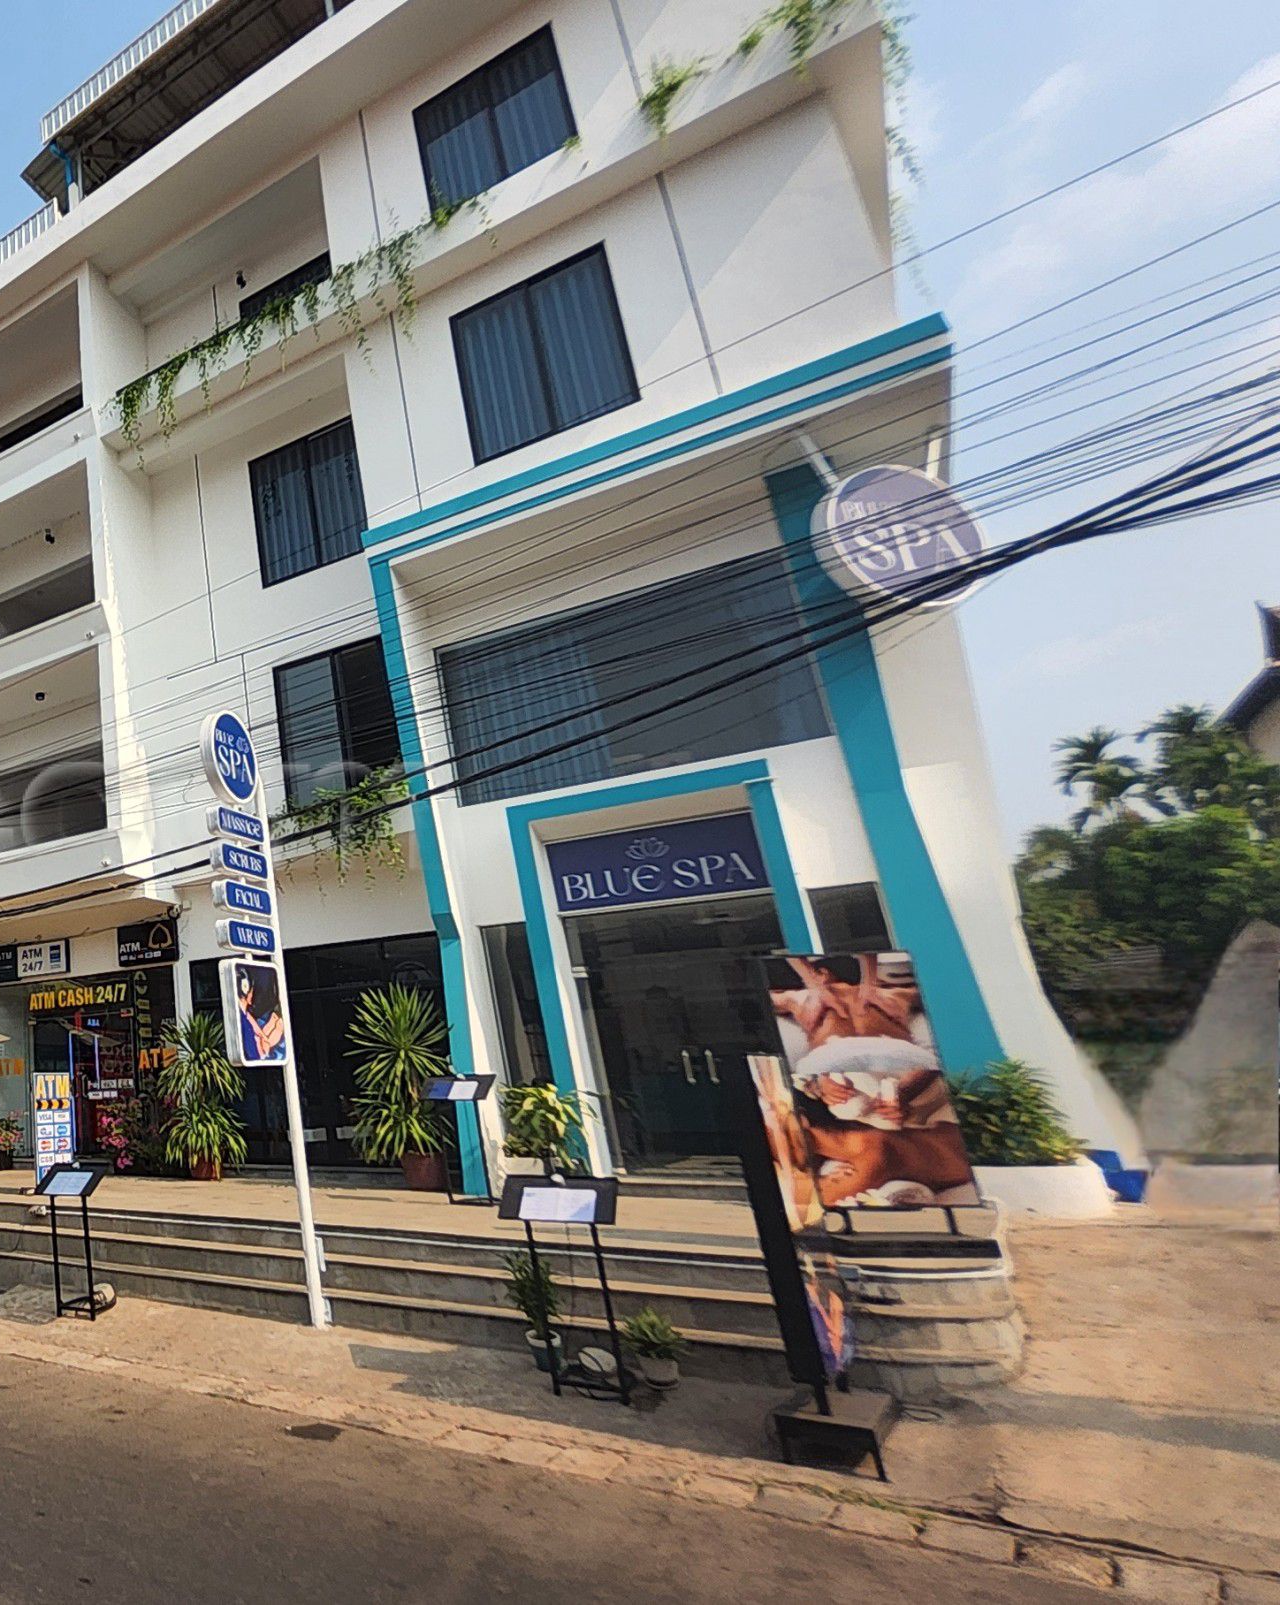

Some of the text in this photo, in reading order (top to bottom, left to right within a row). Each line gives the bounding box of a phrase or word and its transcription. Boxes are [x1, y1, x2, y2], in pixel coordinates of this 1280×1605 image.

[852, 521, 972, 572] SPA
[217, 744, 255, 787] SPA
[220, 812, 263, 838] MASSAGE
[228, 850, 263, 873] SCRUBS
[562, 852, 757, 903] BLUE SPA
[235, 887, 264, 909] FACIAL
[120, 941, 141, 954] ATM
[236, 926, 269, 948] WRAPS
[22, 947, 43, 960] ATM
[22, 961, 44, 973] 24/7
[29, 983, 127, 1012] ATM CASH 24/7
[35, 1075, 70, 1099] ATM
